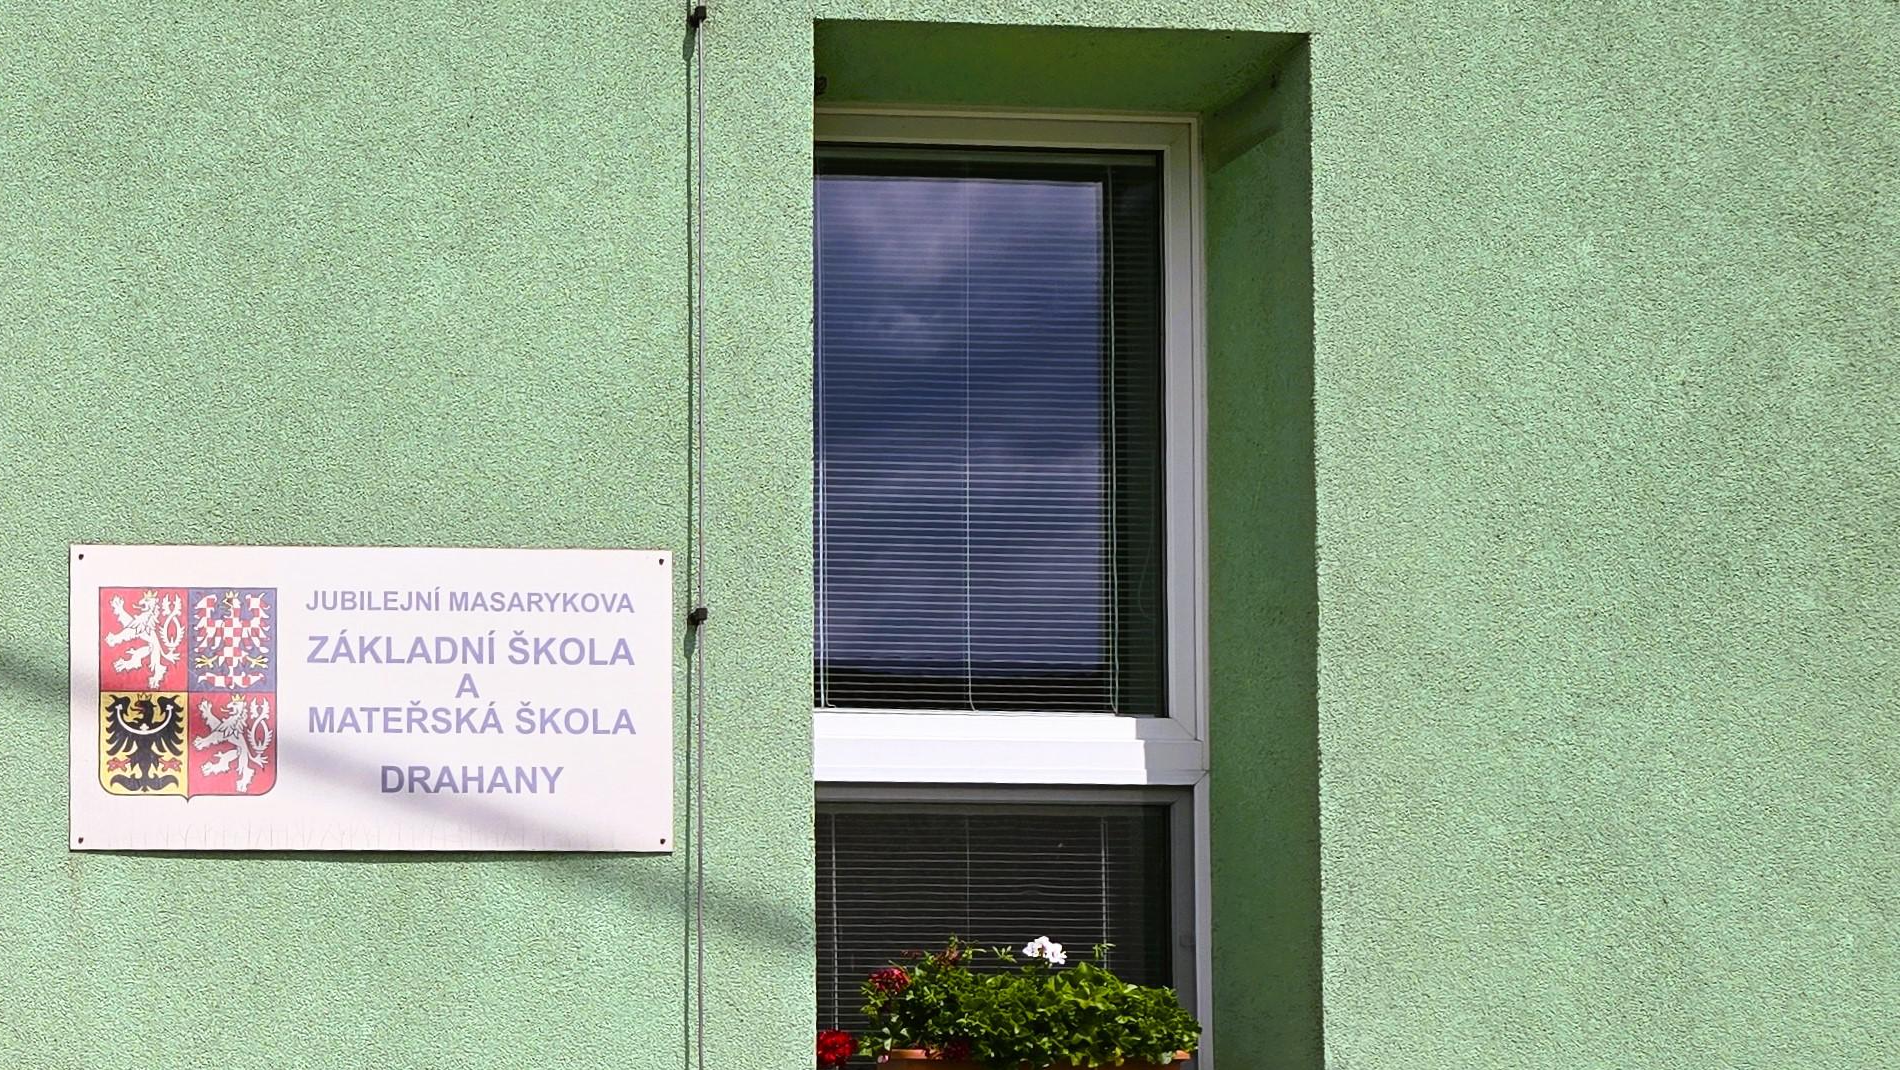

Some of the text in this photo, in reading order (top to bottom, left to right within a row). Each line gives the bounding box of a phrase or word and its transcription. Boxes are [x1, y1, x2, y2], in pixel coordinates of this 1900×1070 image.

[305, 587, 635, 613] JUBILEJNÍ MASARYKOVA
[307, 629, 635, 666] ZÁKLADNÍ ŠKOLA
[455, 673, 479, 698] A
[308, 701, 636, 735] MATEŘSKÁ ŠKOLA
[381, 765, 564, 794] DRAHANY
